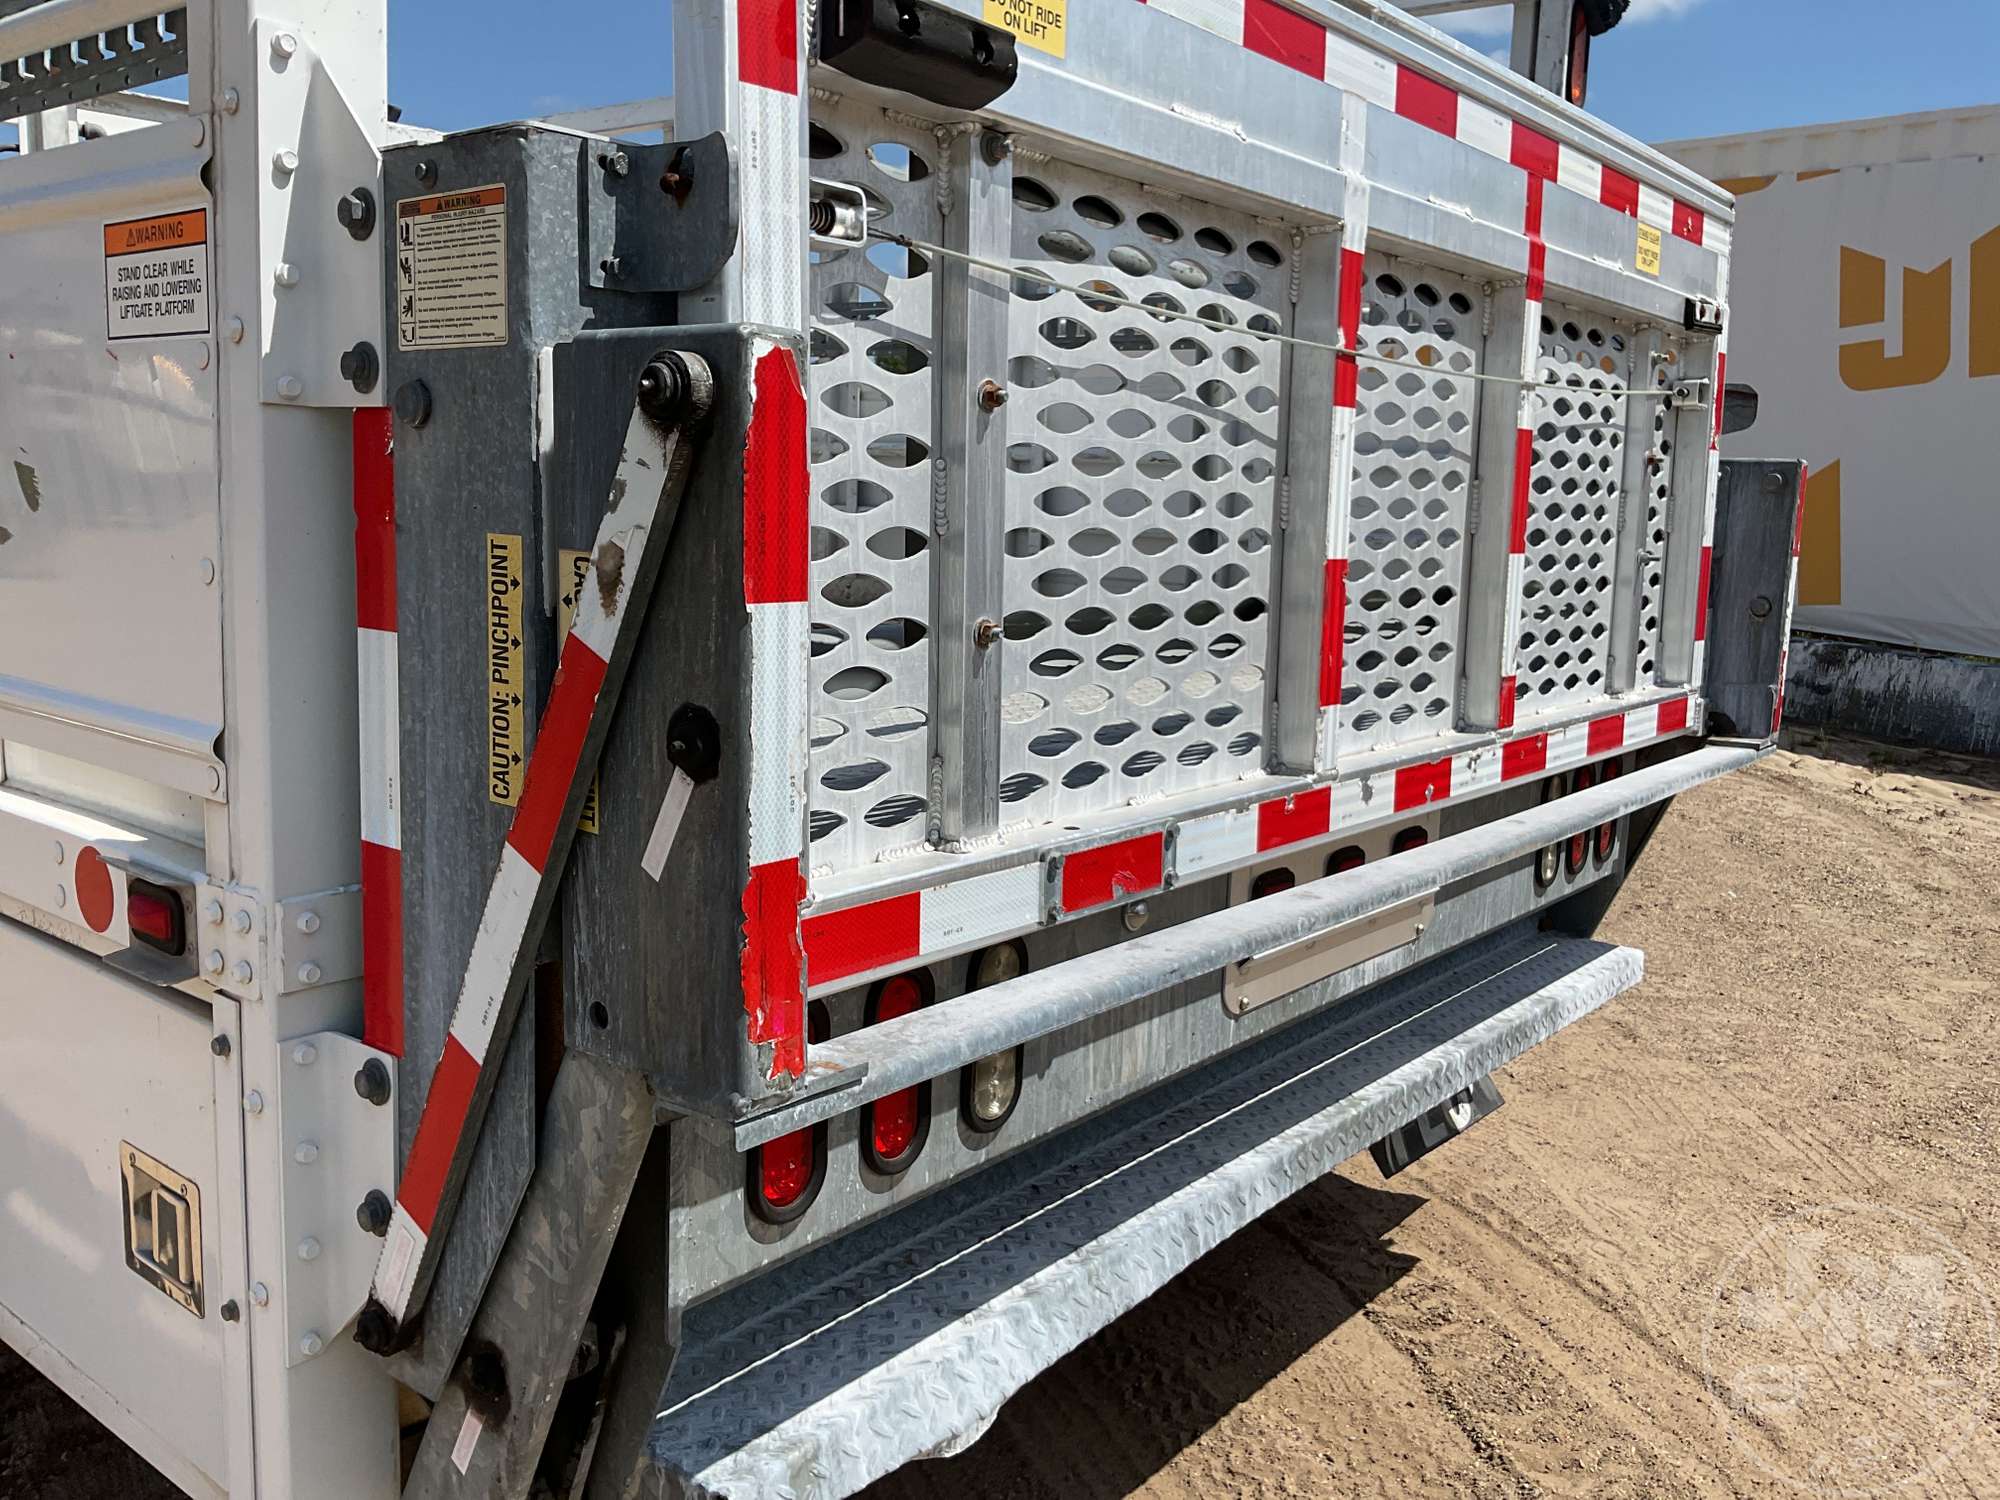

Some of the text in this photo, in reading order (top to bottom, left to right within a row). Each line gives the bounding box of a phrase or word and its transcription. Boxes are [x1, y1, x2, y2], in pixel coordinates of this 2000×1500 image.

[1003, 11, 1048, 40] ON LIFT
[1009, 0, 1062, 29] NOT RIDE
[444, 194, 481, 210] WARNING
[135, 220, 184, 244] WARNING
[117, 258, 195, 282] STAND CLEAR WHILE
[112, 278, 202, 302] RAISING AND LOWERING
[120, 299, 195, 320] LIFTGATE PLATFORM
[490, 538, 511, 801] CAUTION: PINCHPOINT
